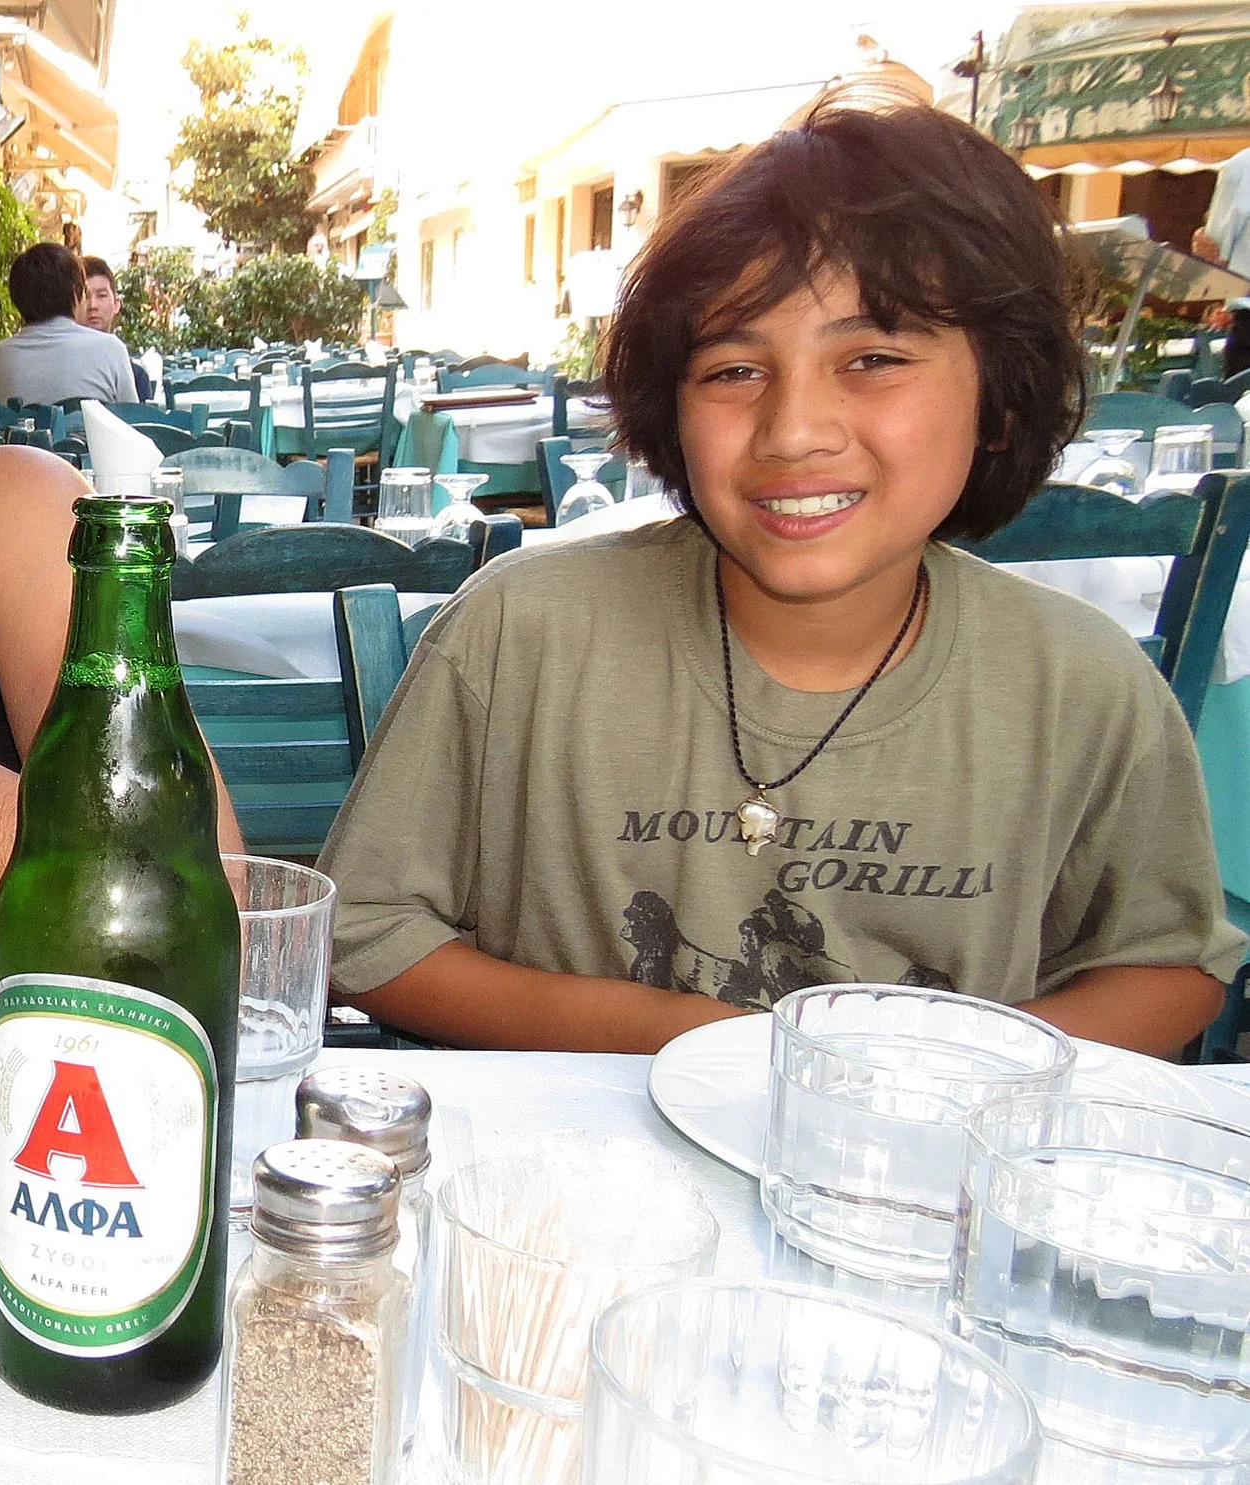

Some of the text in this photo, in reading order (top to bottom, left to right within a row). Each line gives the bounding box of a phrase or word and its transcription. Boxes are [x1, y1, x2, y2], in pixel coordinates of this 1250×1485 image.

[617, 810, 912, 854] MOUTAIN
[53, 1034, 100, 1053] 1961
[10, 1181, 144, 1238] ΑΛΦΑ
[31, 1272, 108, 1297] ALFA BEER
[2, 1285, 97, 1335] TRADITIONALLY
